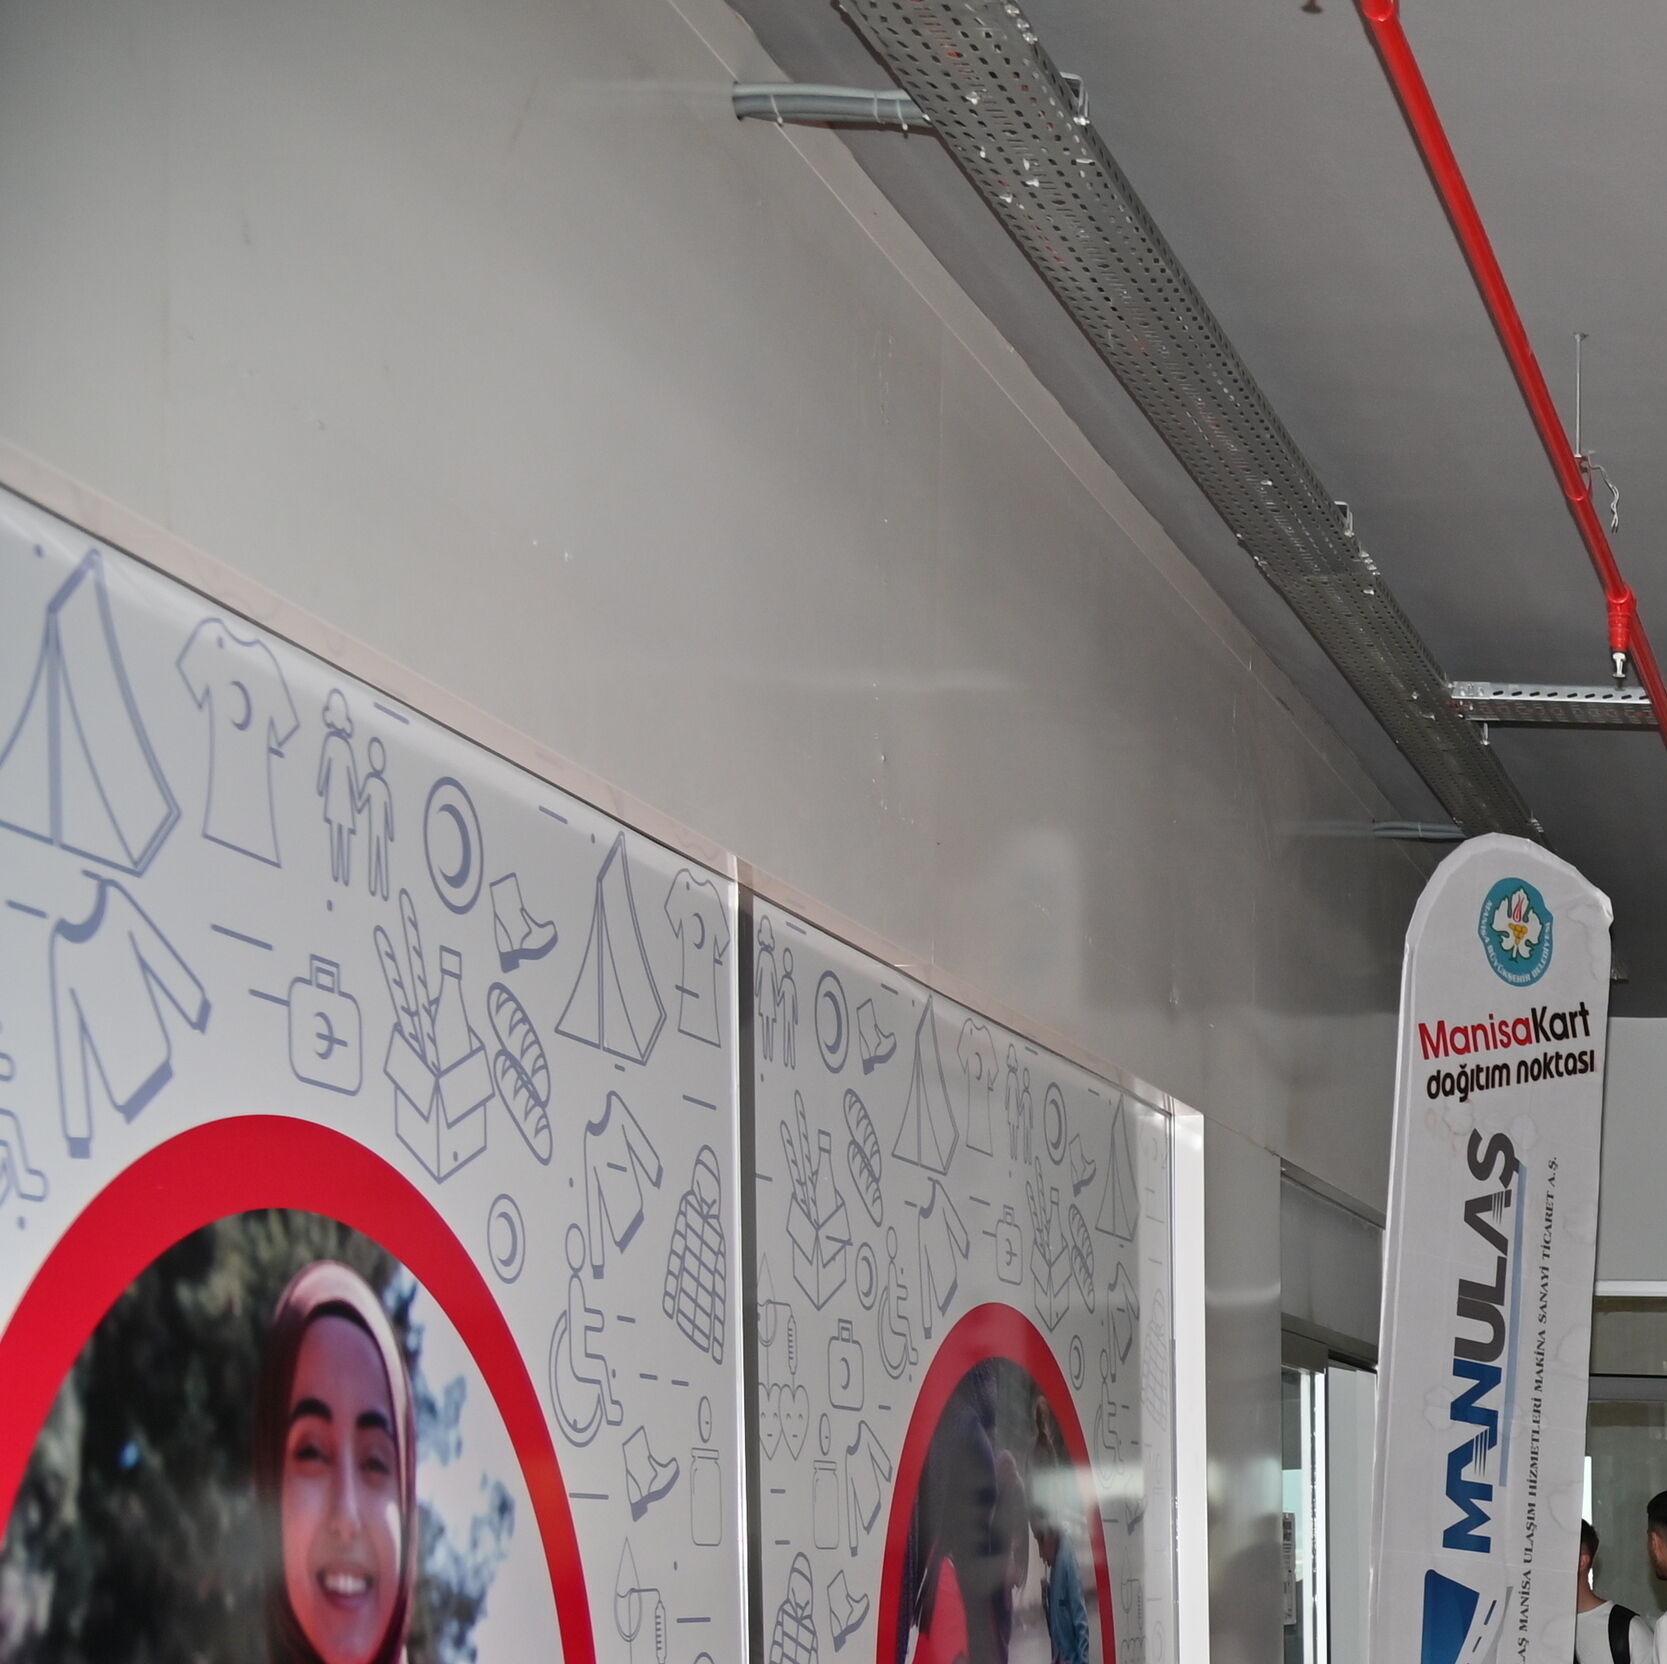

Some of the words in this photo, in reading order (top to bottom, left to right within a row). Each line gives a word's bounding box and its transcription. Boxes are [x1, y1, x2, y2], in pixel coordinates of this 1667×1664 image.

[1418, 1002, 1591, 1060] ManisaKart
[1427, 1063, 1511, 1103] dağıtım
[1516, 1049, 1595, 1085] noktası
[1541, 1190, 1555, 1260] TİCARET
[1537, 1266, 1551, 1324] SANAYİ
[1442, 1128, 1520, 1554] MANULAŞ
[1533, 1330, 1546, 1392] MAKİNA
[1526, 1397, 1542, 1497] HİZMETLERİ
[1523, 1501, 1538, 1564] ULAŞIM
[1518, 1569, 1532, 1632] MANİSA
